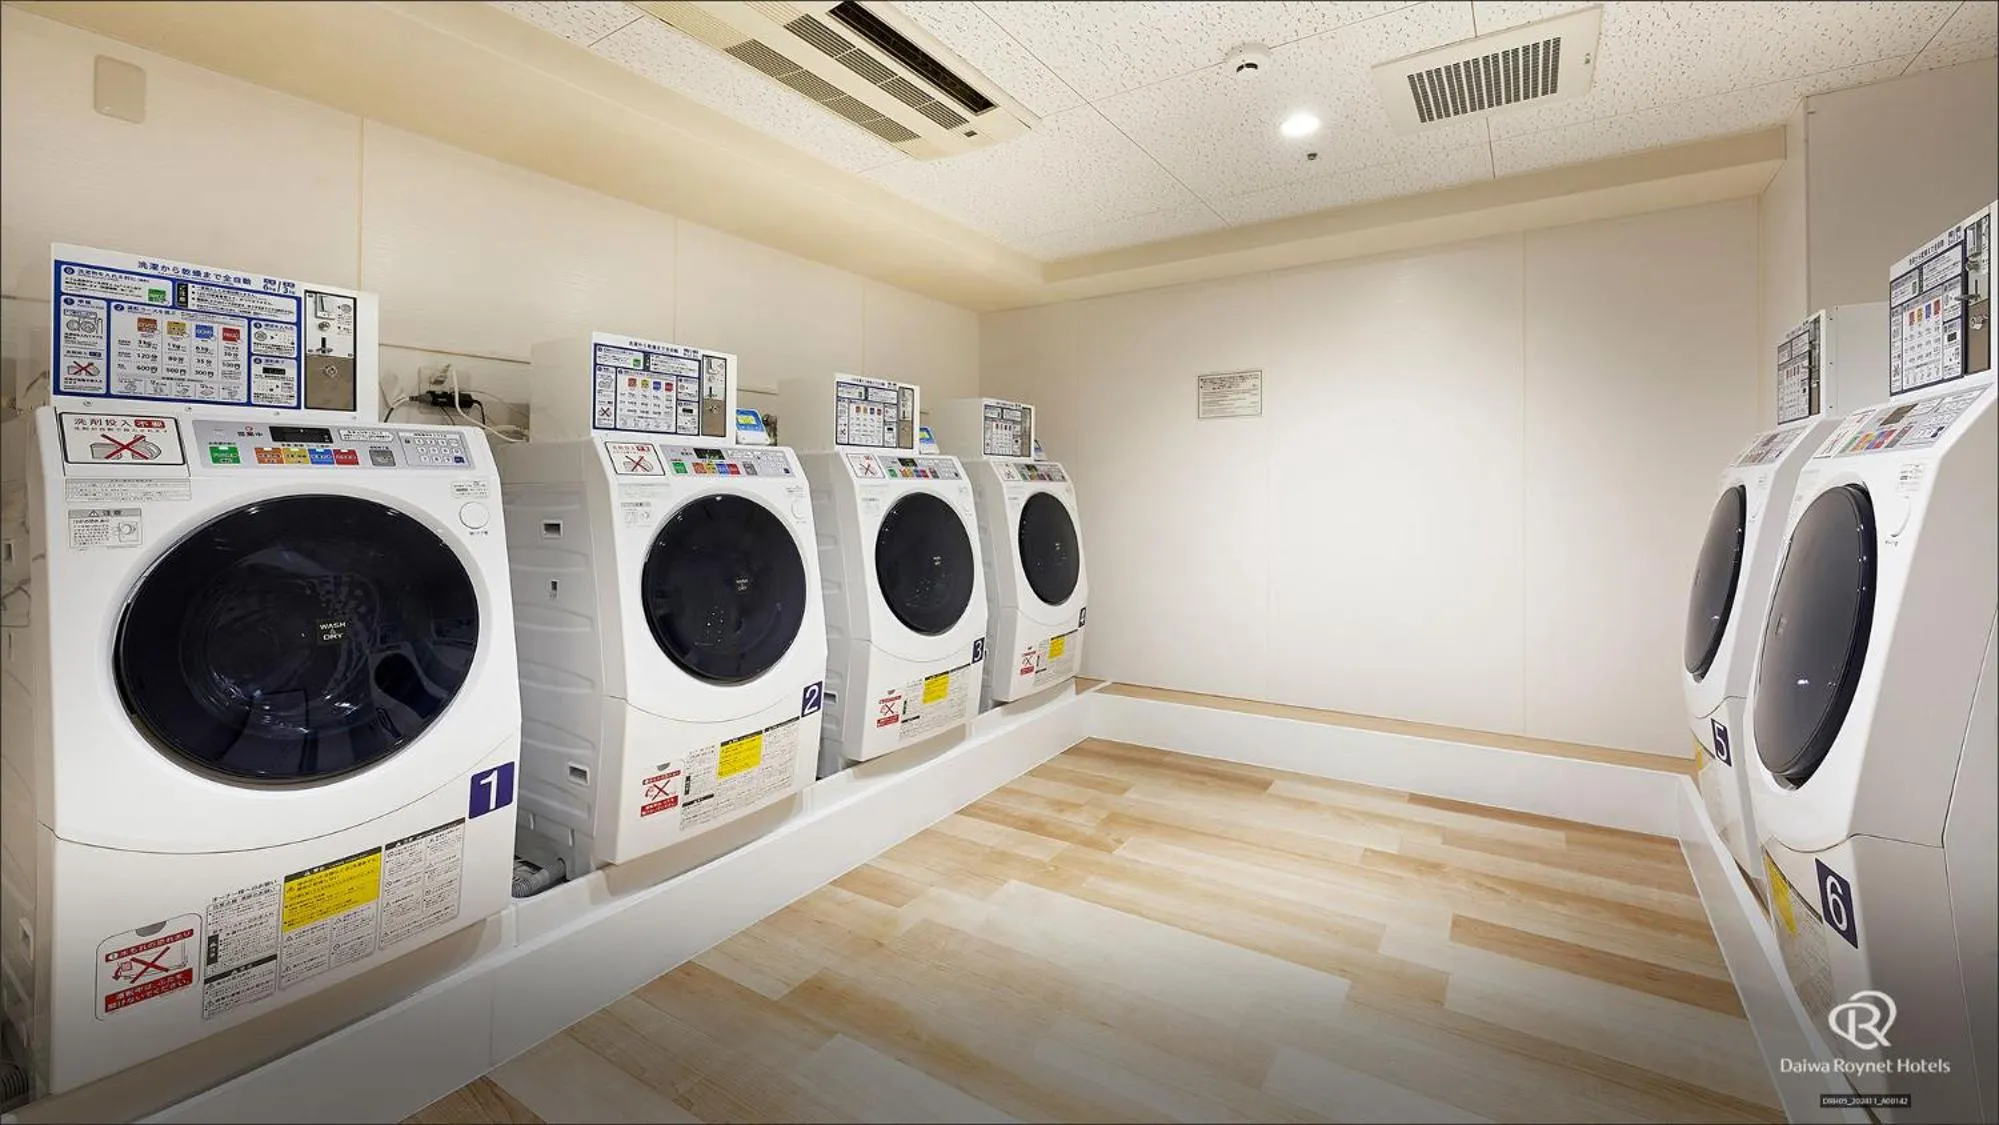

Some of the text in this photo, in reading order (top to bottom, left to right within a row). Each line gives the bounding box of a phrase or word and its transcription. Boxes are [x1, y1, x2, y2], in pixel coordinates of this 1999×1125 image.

[138, 261, 252, 286] 洗濯から乾燥まで全自動
[320, 622, 346, 630] WASH
[804, 685, 819, 715] 2
[1713, 721, 1727, 761] 5
[1826, 875, 1848, 931] 6
